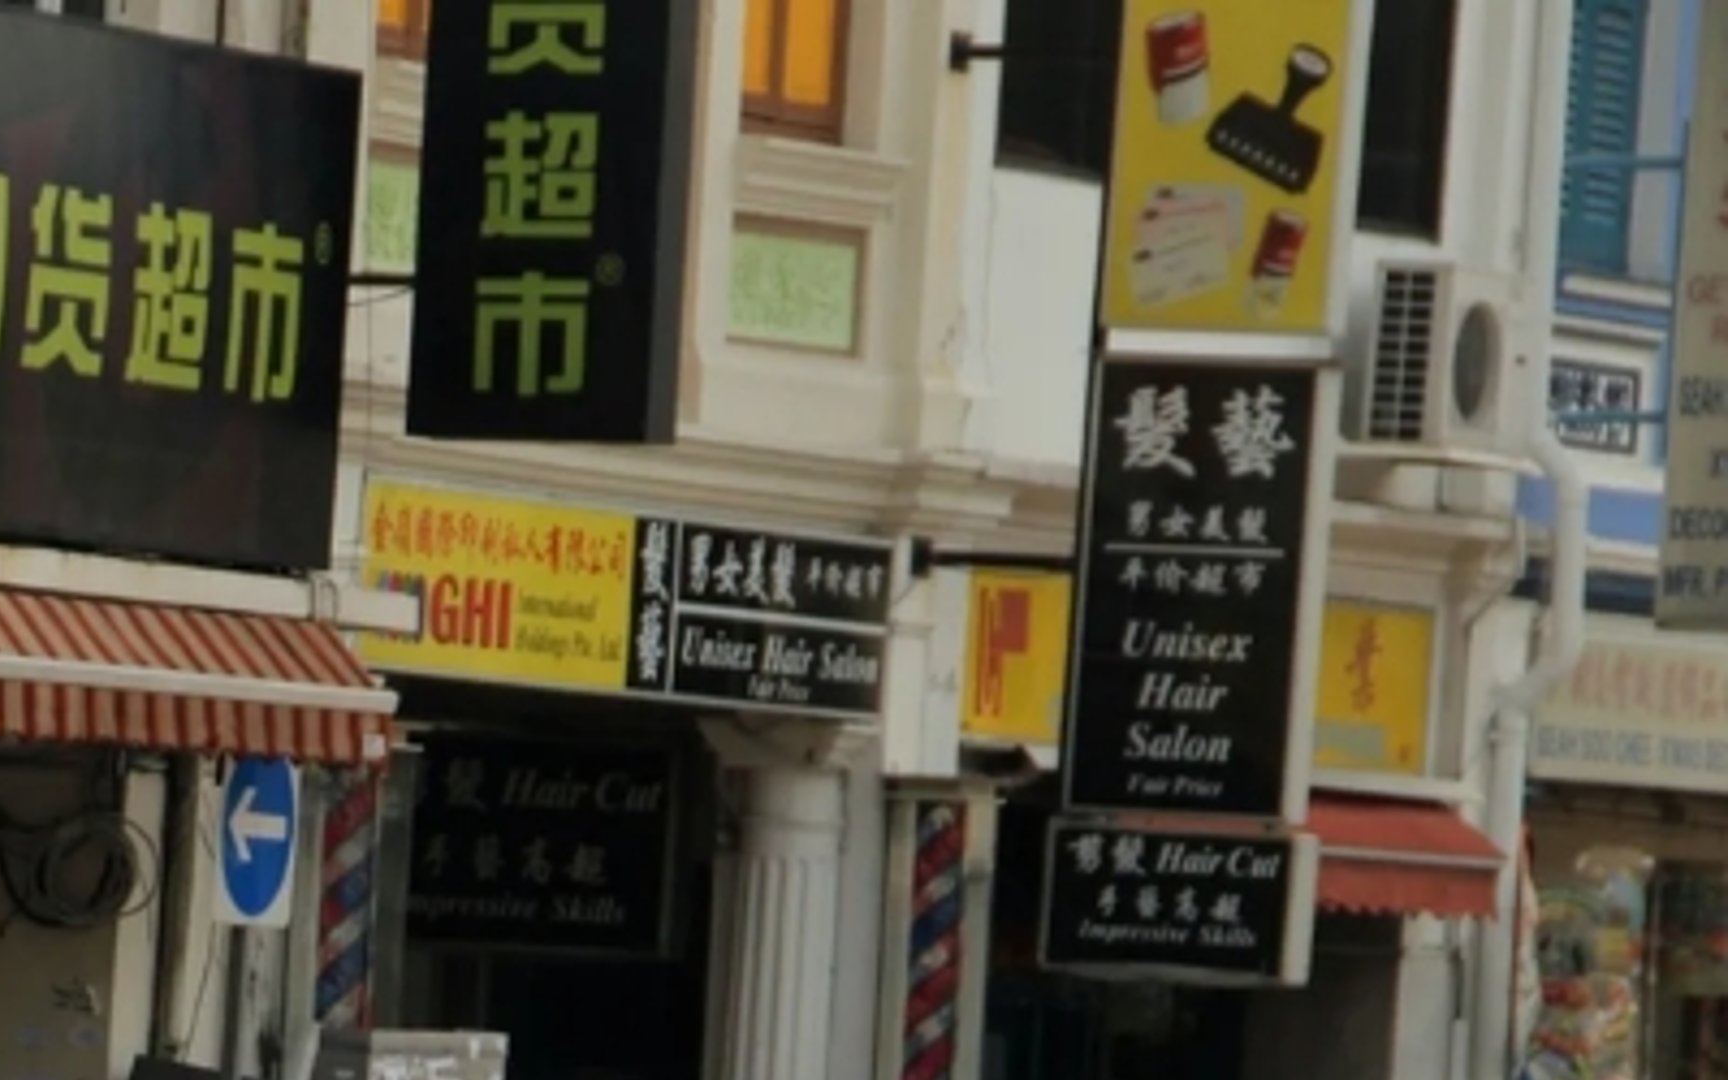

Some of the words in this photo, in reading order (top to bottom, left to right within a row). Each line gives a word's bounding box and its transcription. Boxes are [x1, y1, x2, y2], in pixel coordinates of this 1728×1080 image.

[1113, 384, 1296, 480] 髮藝
[430, 572, 515, 650] GHI
[681, 625, 756, 672] Unisex
[764, 633, 813, 676] Hair
[818, 642, 879, 685] Salon
[1122, 620, 1254, 665] Unisex
[1136, 671, 1230, 713] Hair
[1122, 722, 1233, 765] Salon
[500, 764, 591, 811] Hair
[595, 770, 665, 814] Cut
[1126, 774, 1168, 795] Fair
[1172, 776, 1225, 798] Price
[1155, 840, 1224, 875] Hair
[1226, 844, 1282, 879] Cut
[407, 890, 540, 925] mpressive
[1077, 917, 1190, 946] Impressive
[1197, 924, 1258, 949] Skills
